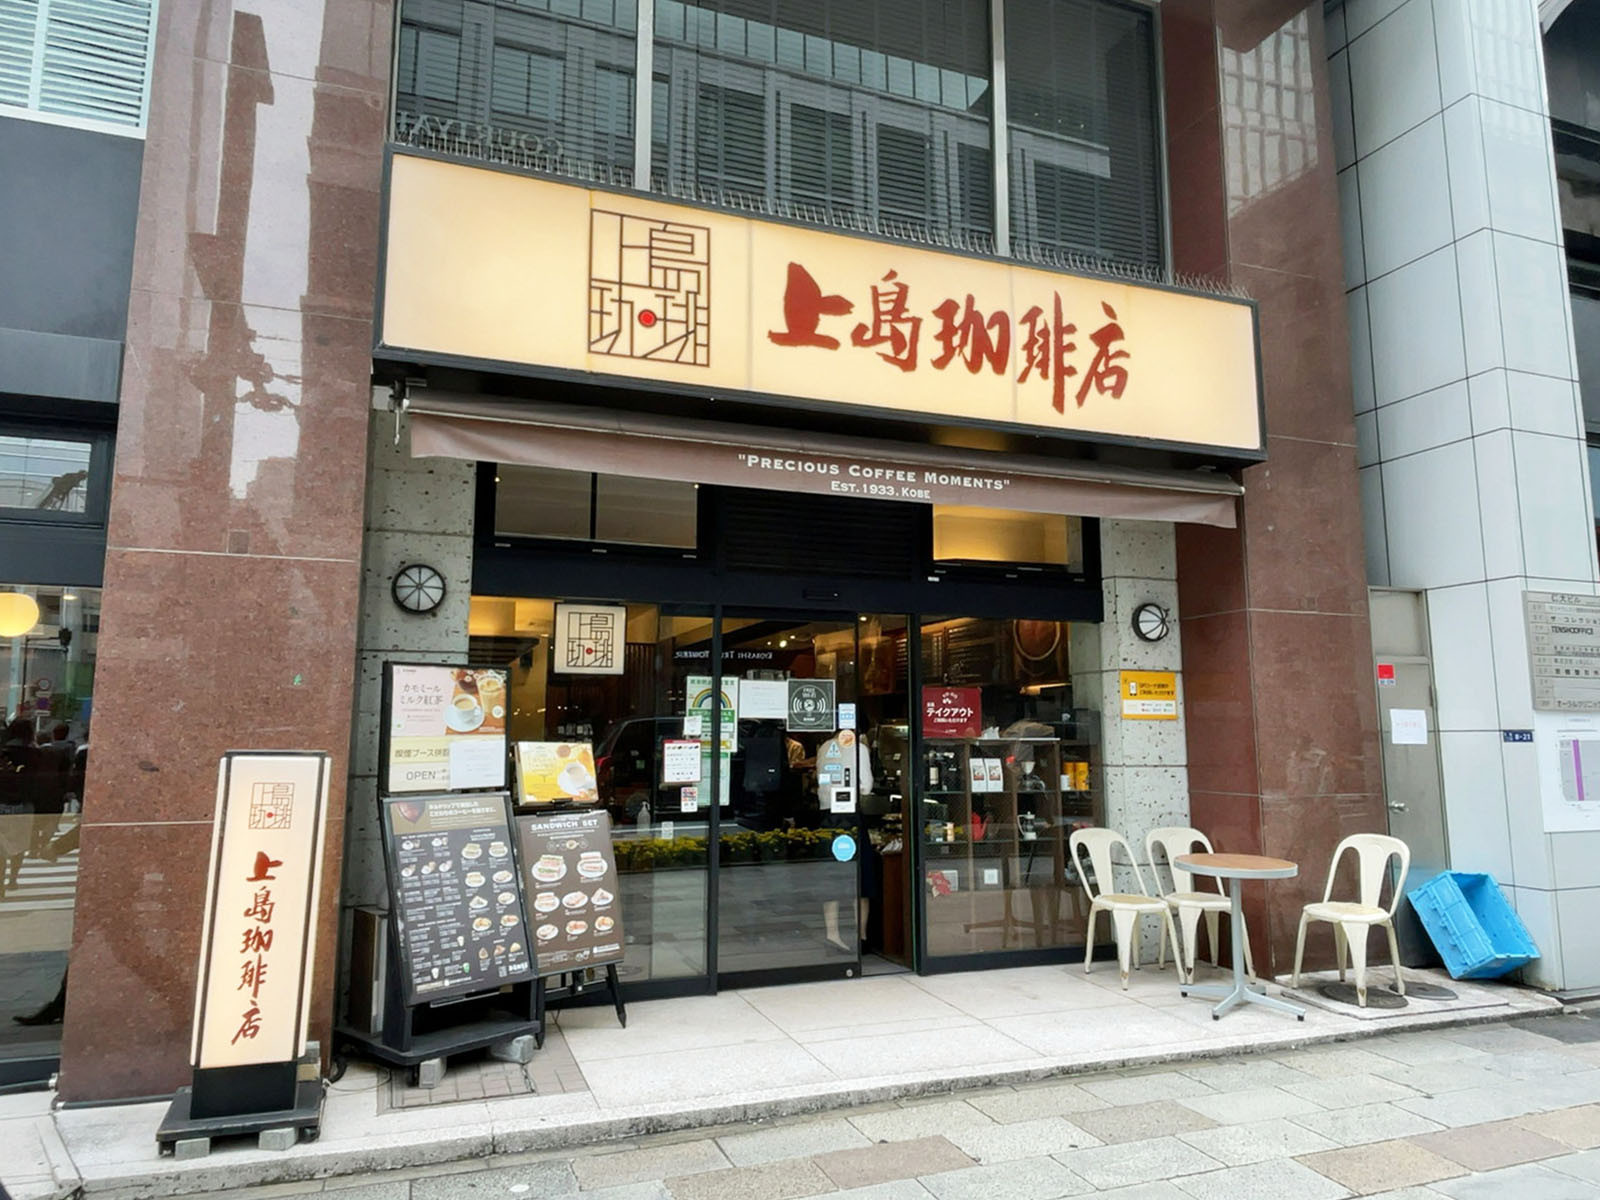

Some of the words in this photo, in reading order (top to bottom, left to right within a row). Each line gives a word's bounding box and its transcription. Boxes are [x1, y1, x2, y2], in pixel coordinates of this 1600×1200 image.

[767, 261, 1131, 415] 上島珈琲店
[926, 707, 974, 718] テイクアウト
[406, 770, 437, 781] OPEN
[531, 820, 579, 831] SANDWICH
[231, 851, 283, 1046] 上島珈琲店
